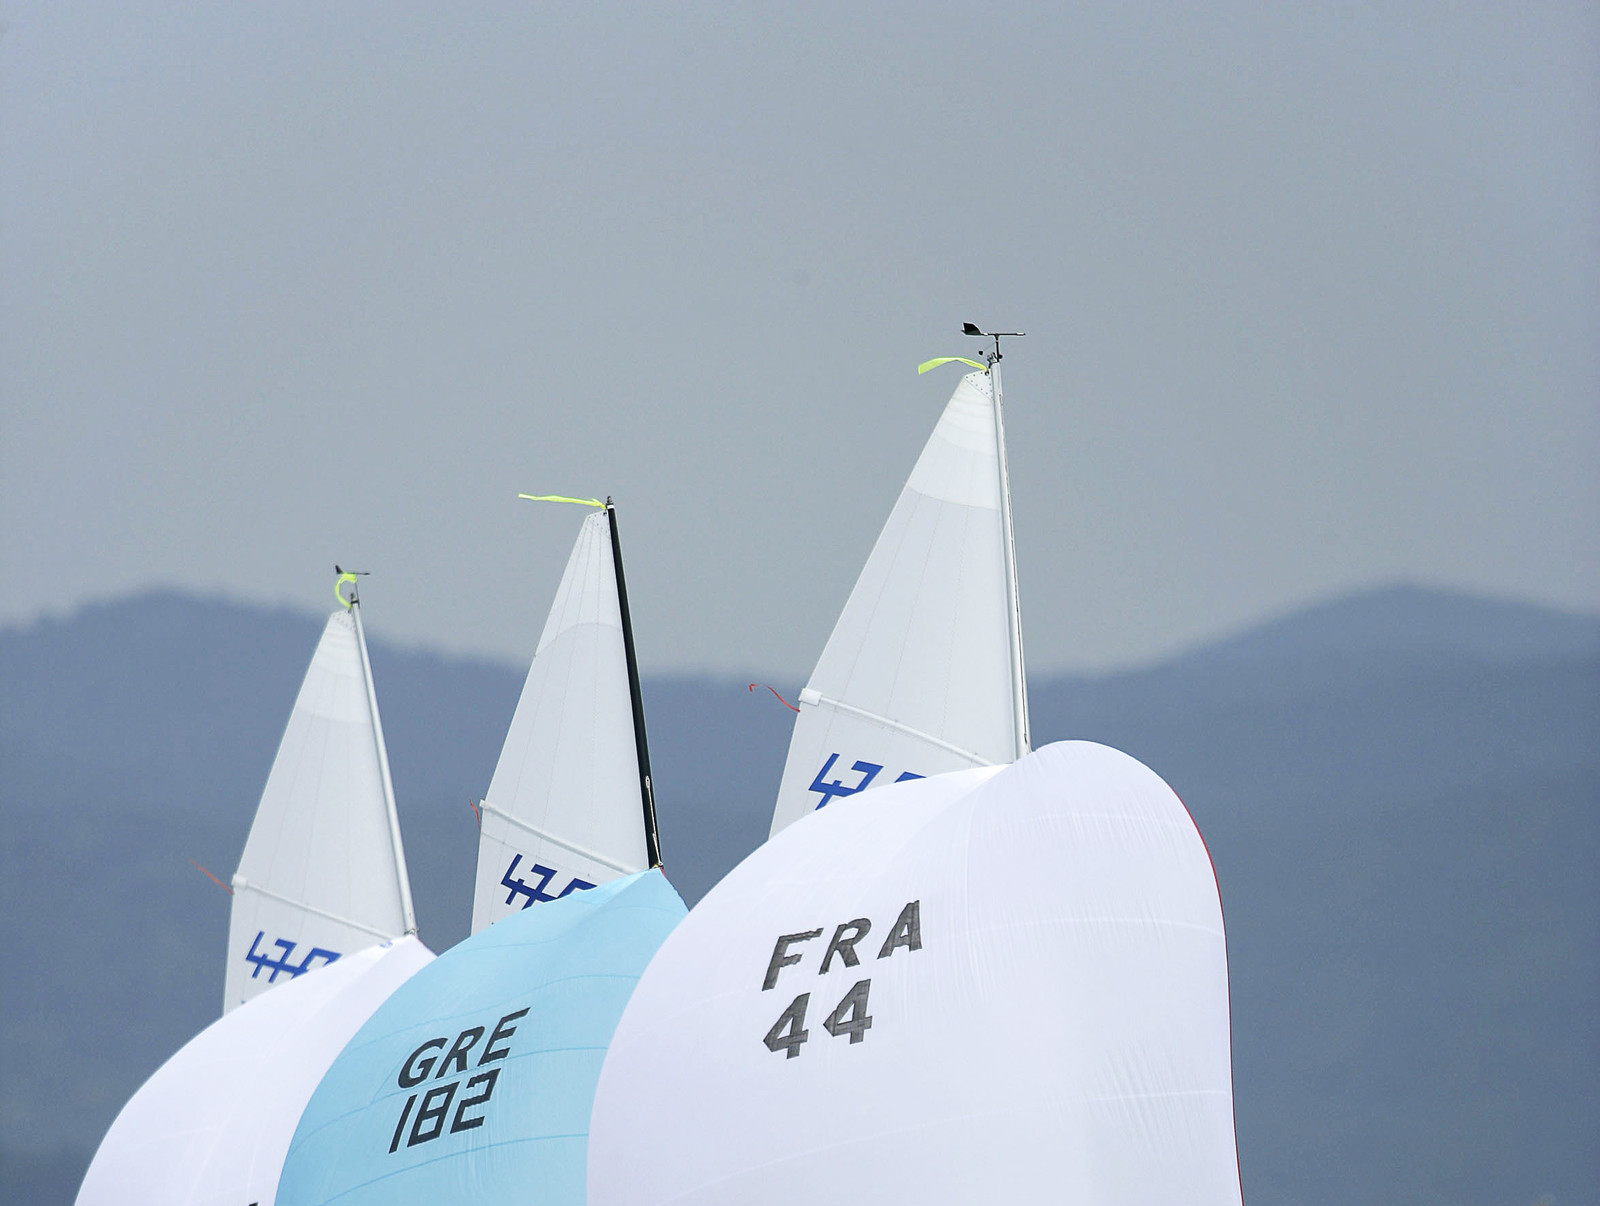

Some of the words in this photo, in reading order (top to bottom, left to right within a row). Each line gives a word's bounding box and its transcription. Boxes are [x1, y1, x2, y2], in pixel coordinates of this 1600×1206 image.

[808, 753, 927, 811] 47
[762, 900, 922, 991] FRA
[398, 1007, 531, 1089] GRE
[763, 979, 872, 1060] 44
[389, 1068, 501, 1154] 182
